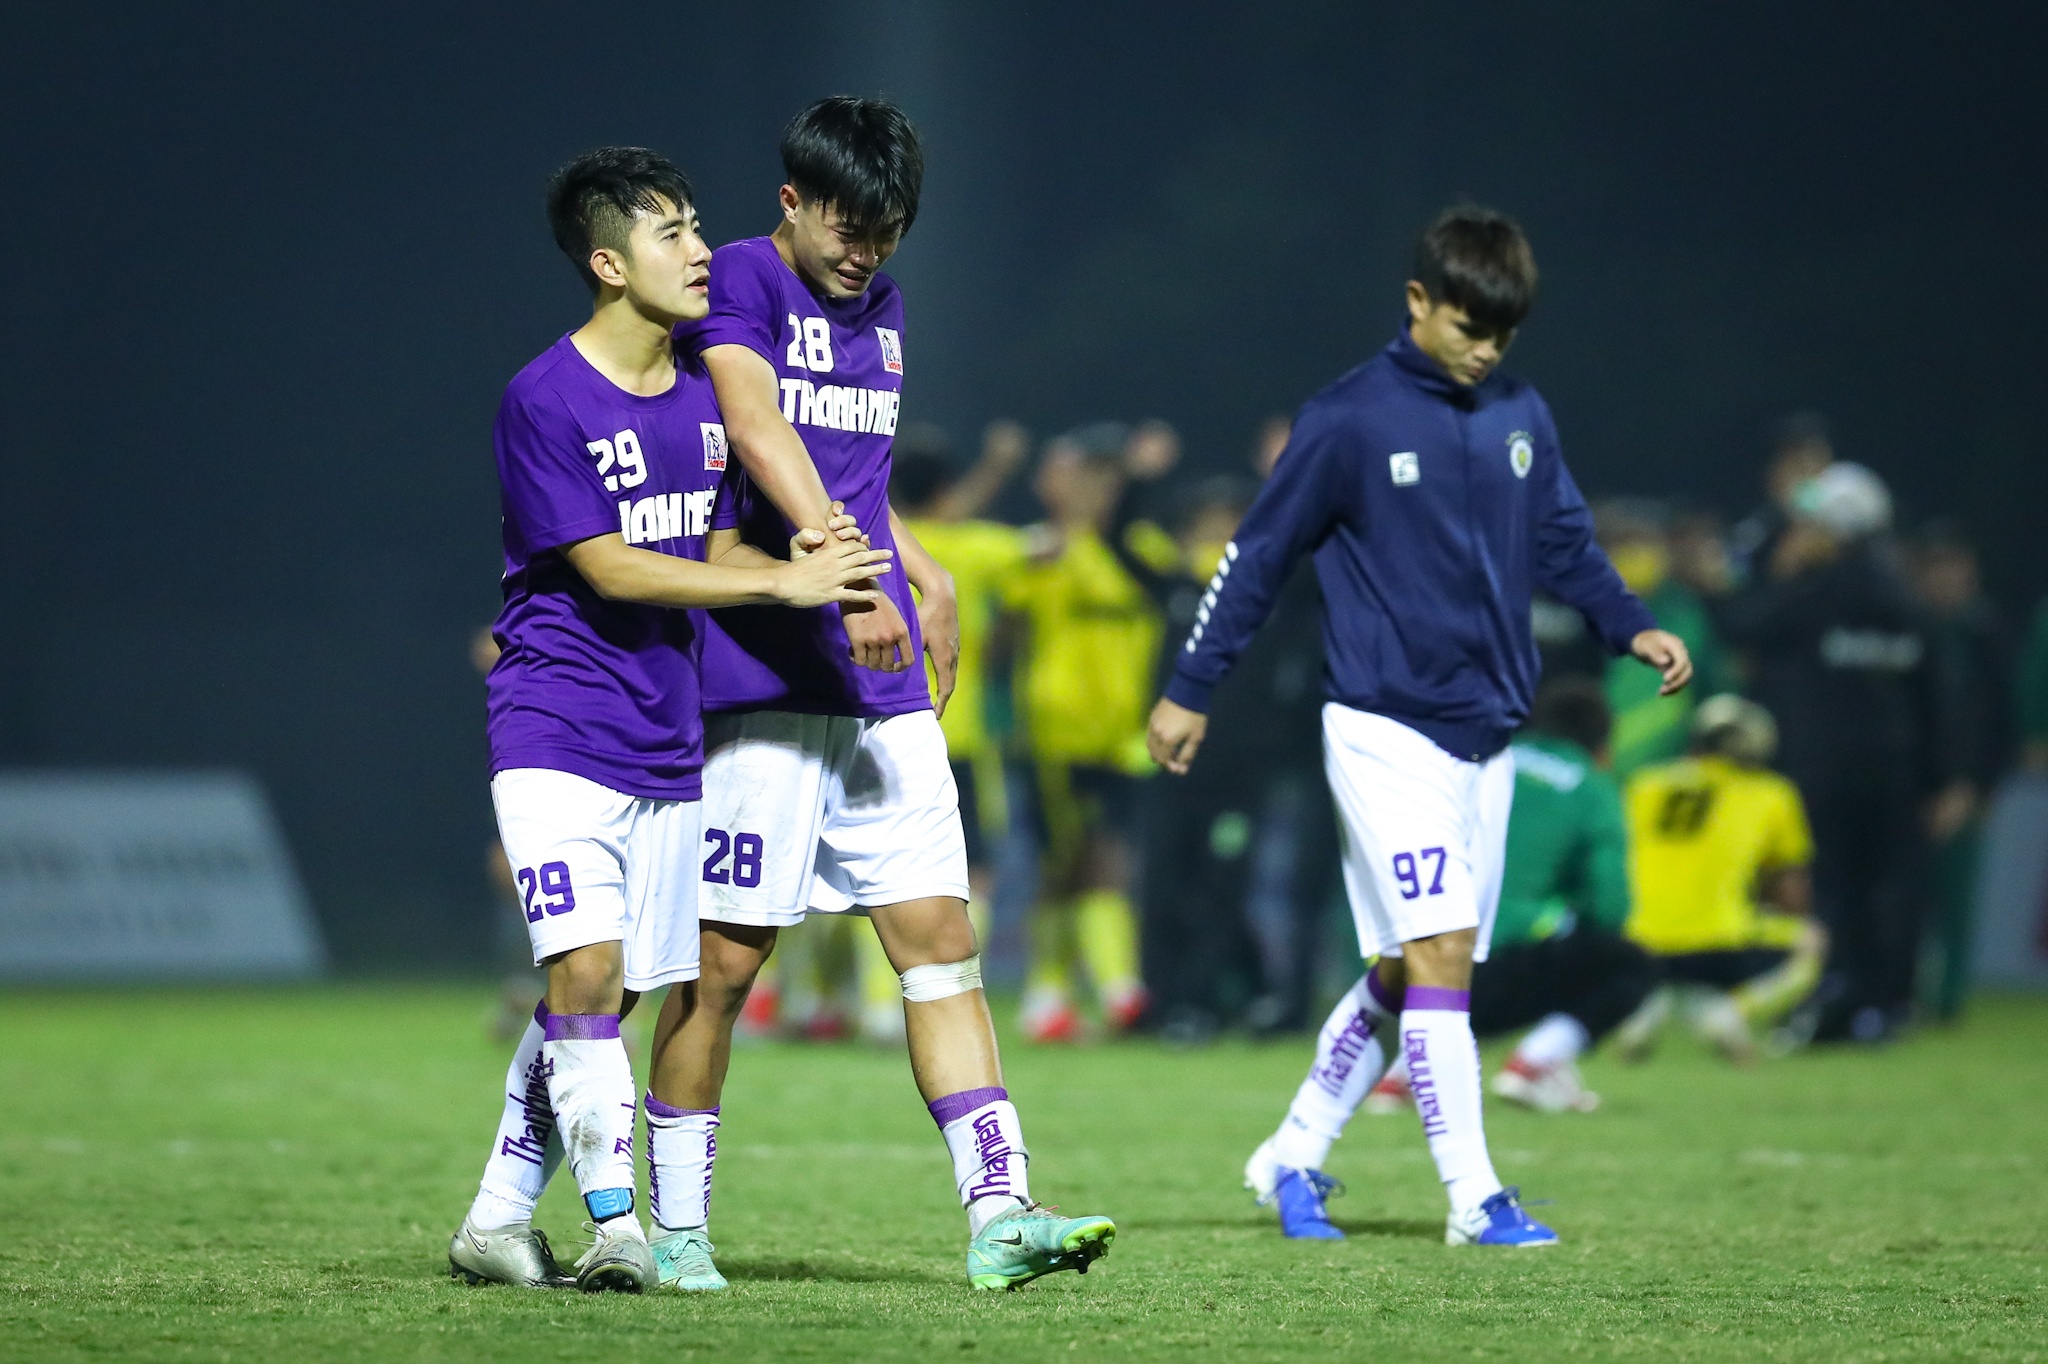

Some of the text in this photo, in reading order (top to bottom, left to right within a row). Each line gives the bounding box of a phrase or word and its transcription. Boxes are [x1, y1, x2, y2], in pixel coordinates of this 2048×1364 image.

[786, 313, 835, 373] 28
[586, 428, 648, 492] 29
[702, 828, 764, 888] 28
[1393, 847, 1447, 900] 97
[518, 861, 576, 924] 29
